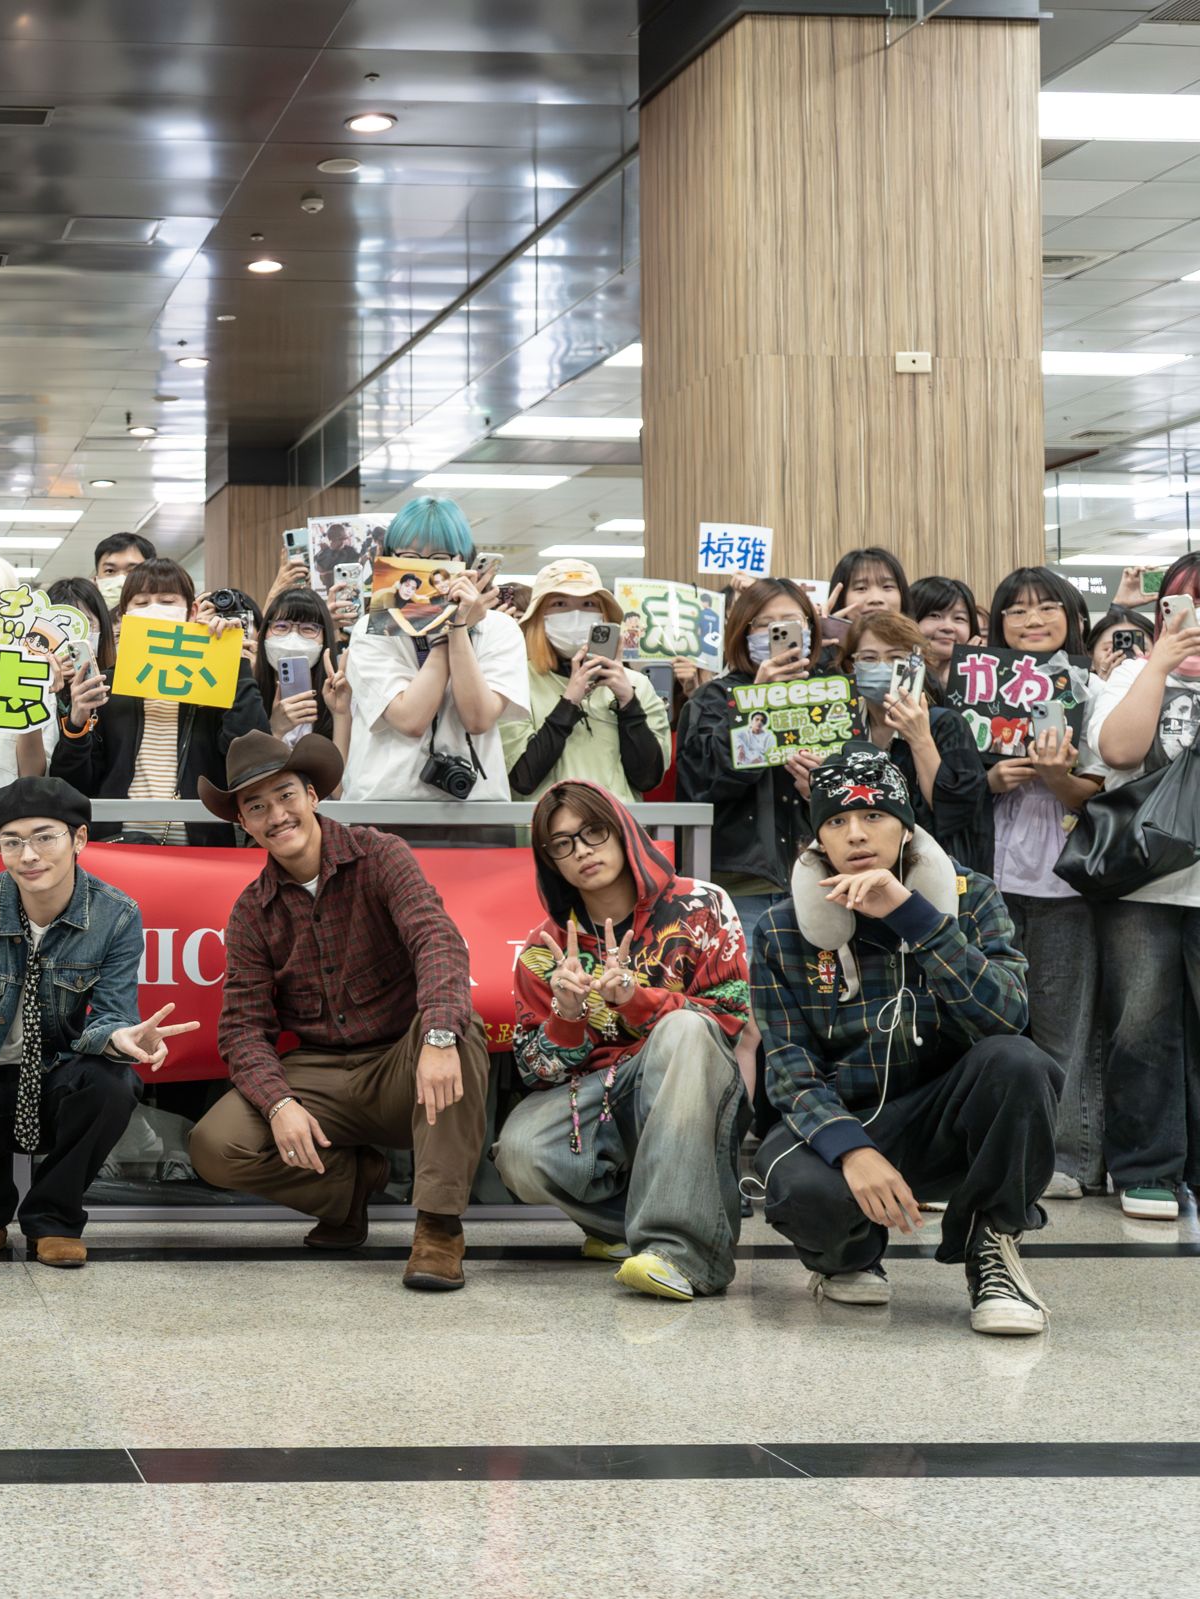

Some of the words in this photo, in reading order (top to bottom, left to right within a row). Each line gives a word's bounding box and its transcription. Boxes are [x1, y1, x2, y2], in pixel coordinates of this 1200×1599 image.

[639, 591, 703, 658] 志
[136, 625, 218, 696] 志
[959, 655, 1052, 711] かわ
[735, 680, 848, 710] weesa
